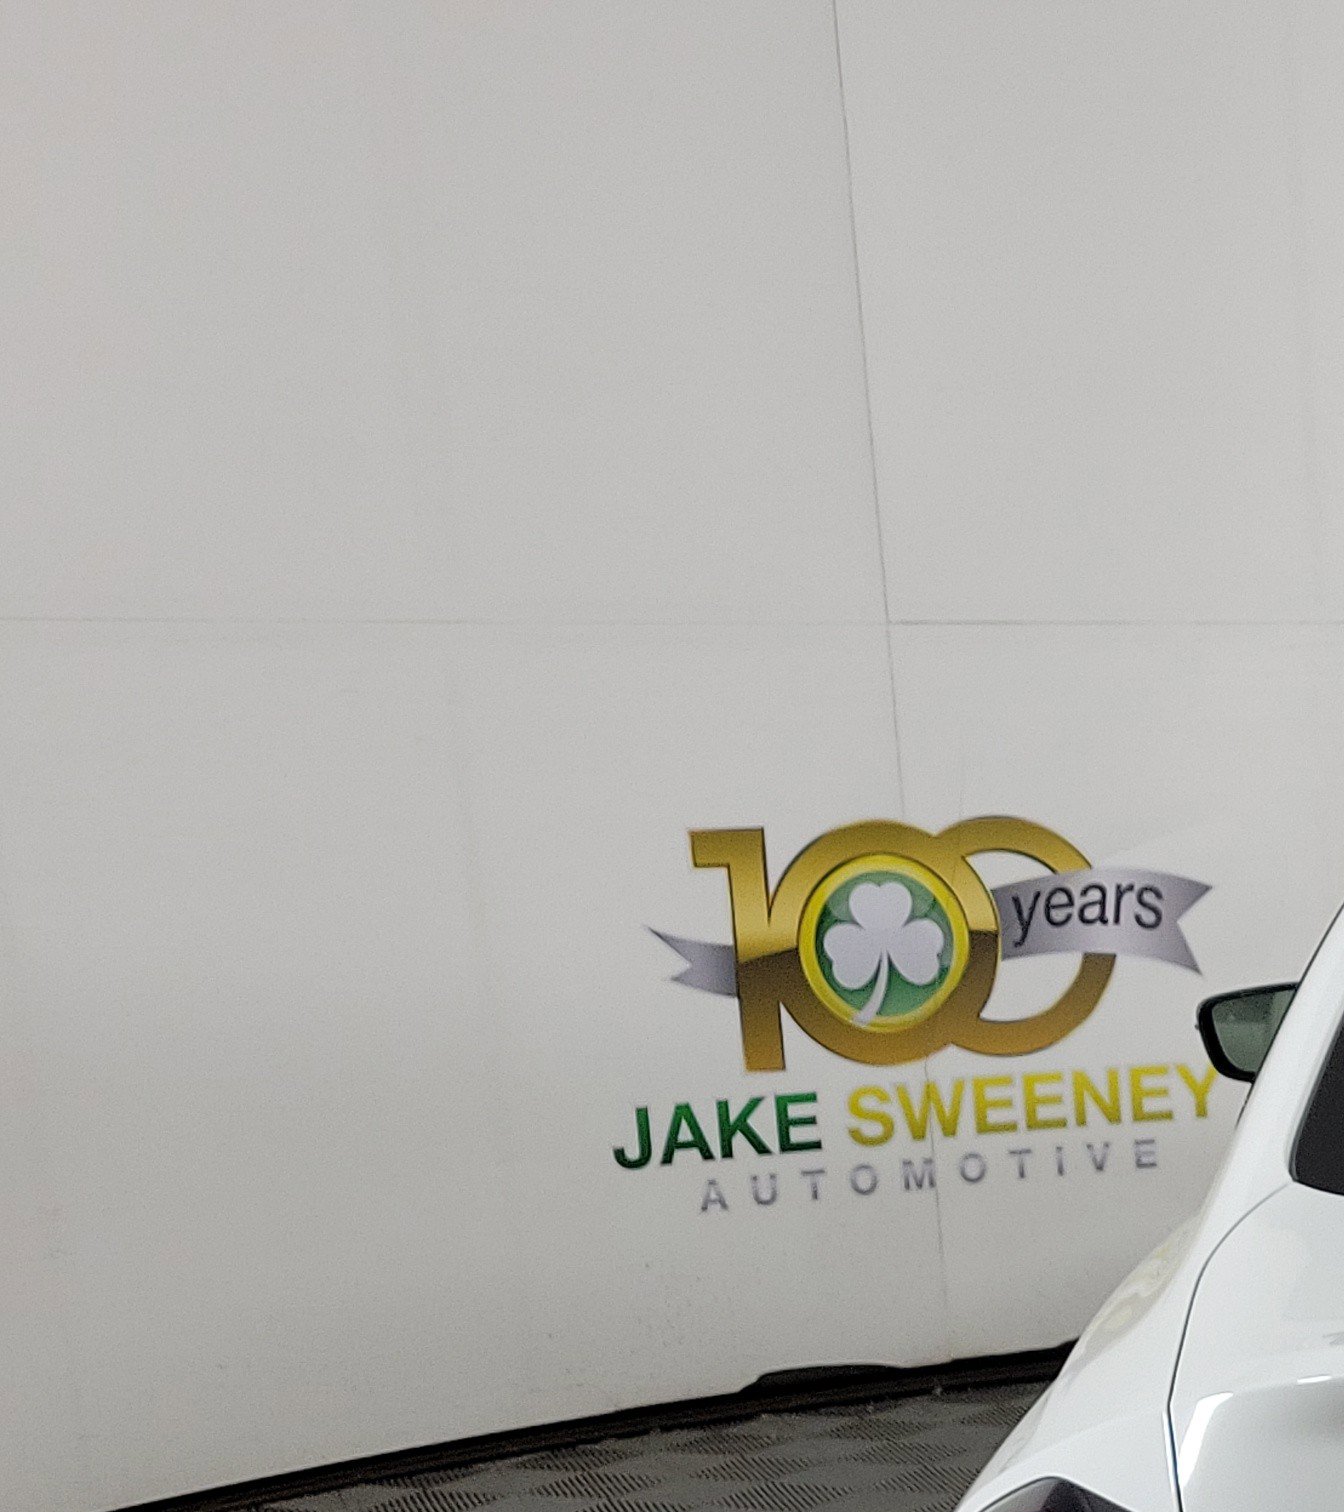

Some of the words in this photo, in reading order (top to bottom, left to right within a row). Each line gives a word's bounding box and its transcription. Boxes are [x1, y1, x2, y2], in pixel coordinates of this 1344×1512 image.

[688, 815, 1117, 1073] 100
[1011, 880, 1164, 948] years
[612, 1091, 823, 1171] JAKE
[846, 1064, 1220, 1148] SWEENEY
[700, 1138, 1159, 1213] AUTOMOTIVE
